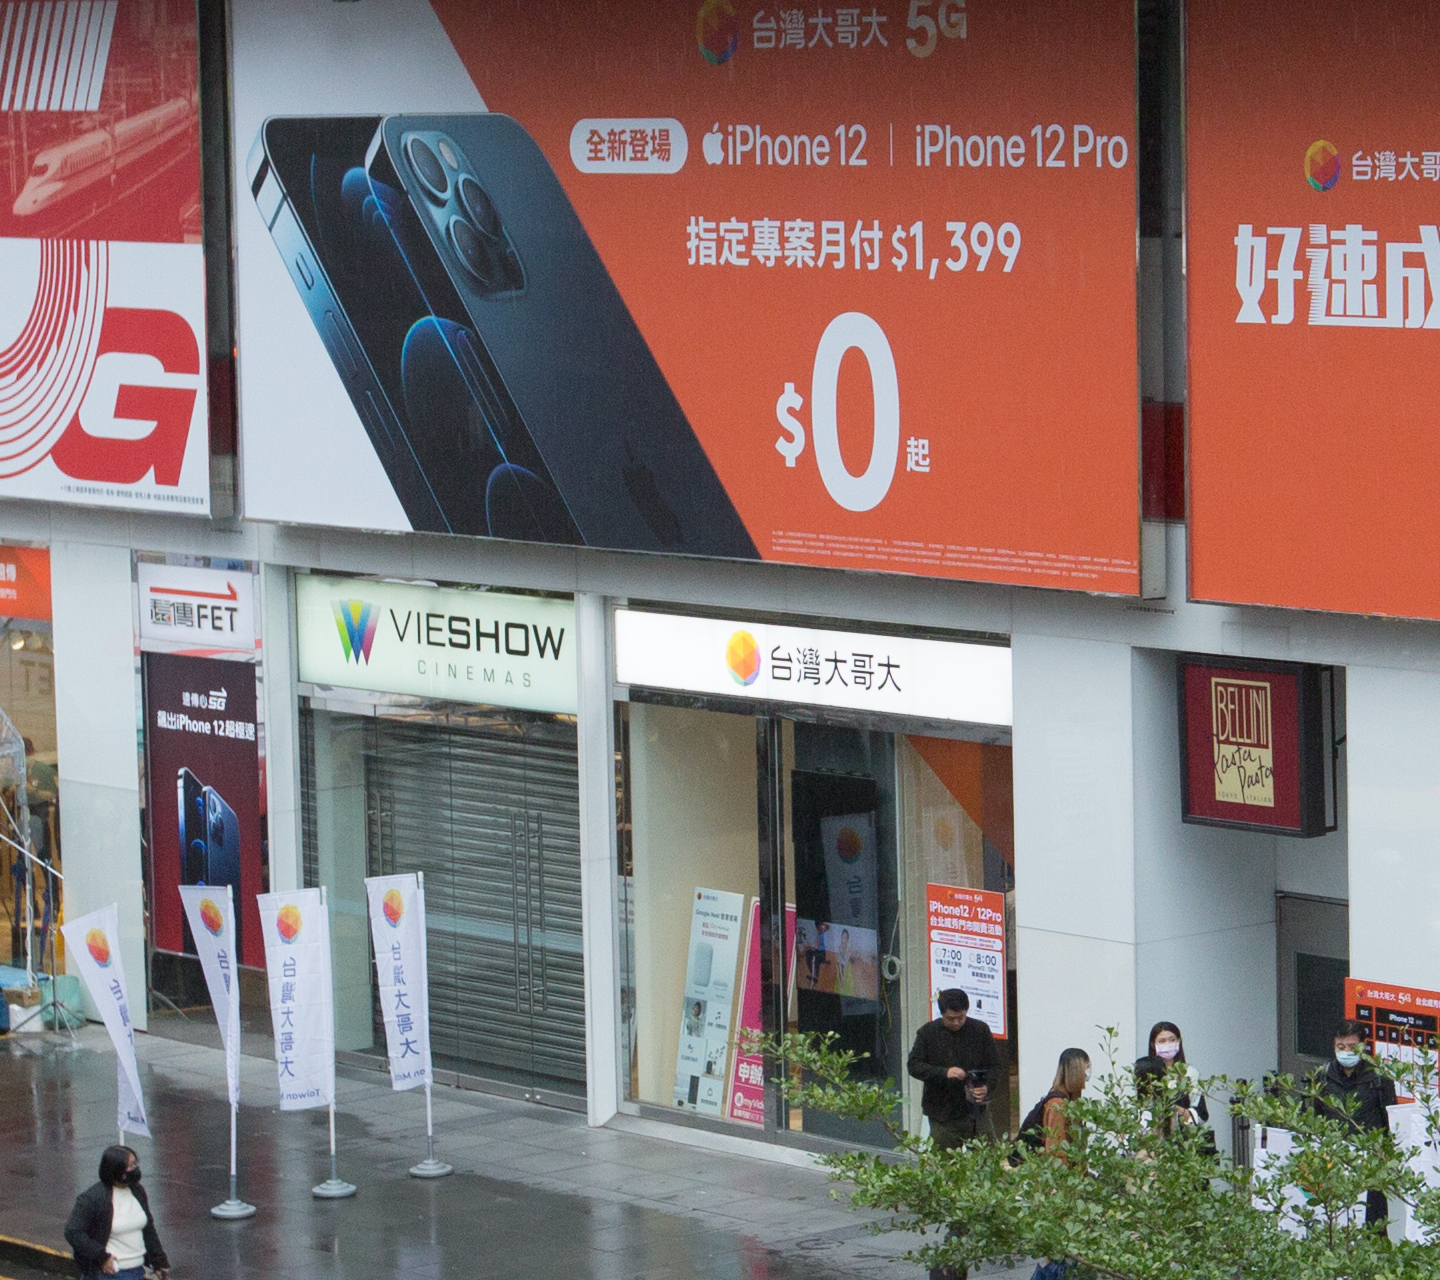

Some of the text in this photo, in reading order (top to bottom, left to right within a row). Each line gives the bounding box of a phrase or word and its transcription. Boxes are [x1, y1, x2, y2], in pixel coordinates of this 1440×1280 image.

[751, 6, 888, 51] 台灣大哥大
[585, 124, 1129, 170] 全新登場 iPhone 12 iPhone 12 Pro
[686, 216, 1023, 279] 指定專案月付 $1,399
[389, 607, 565, 663] VIESHOW
[417, 659, 532, 689] CINEMAS
[769, 644, 903, 692] 台灣大哥大
[1216, 685, 1267, 746] BELLINI
[1210, 733, 1257, 784] Pasta
[1237, 755, 1274, 803] Pasta
